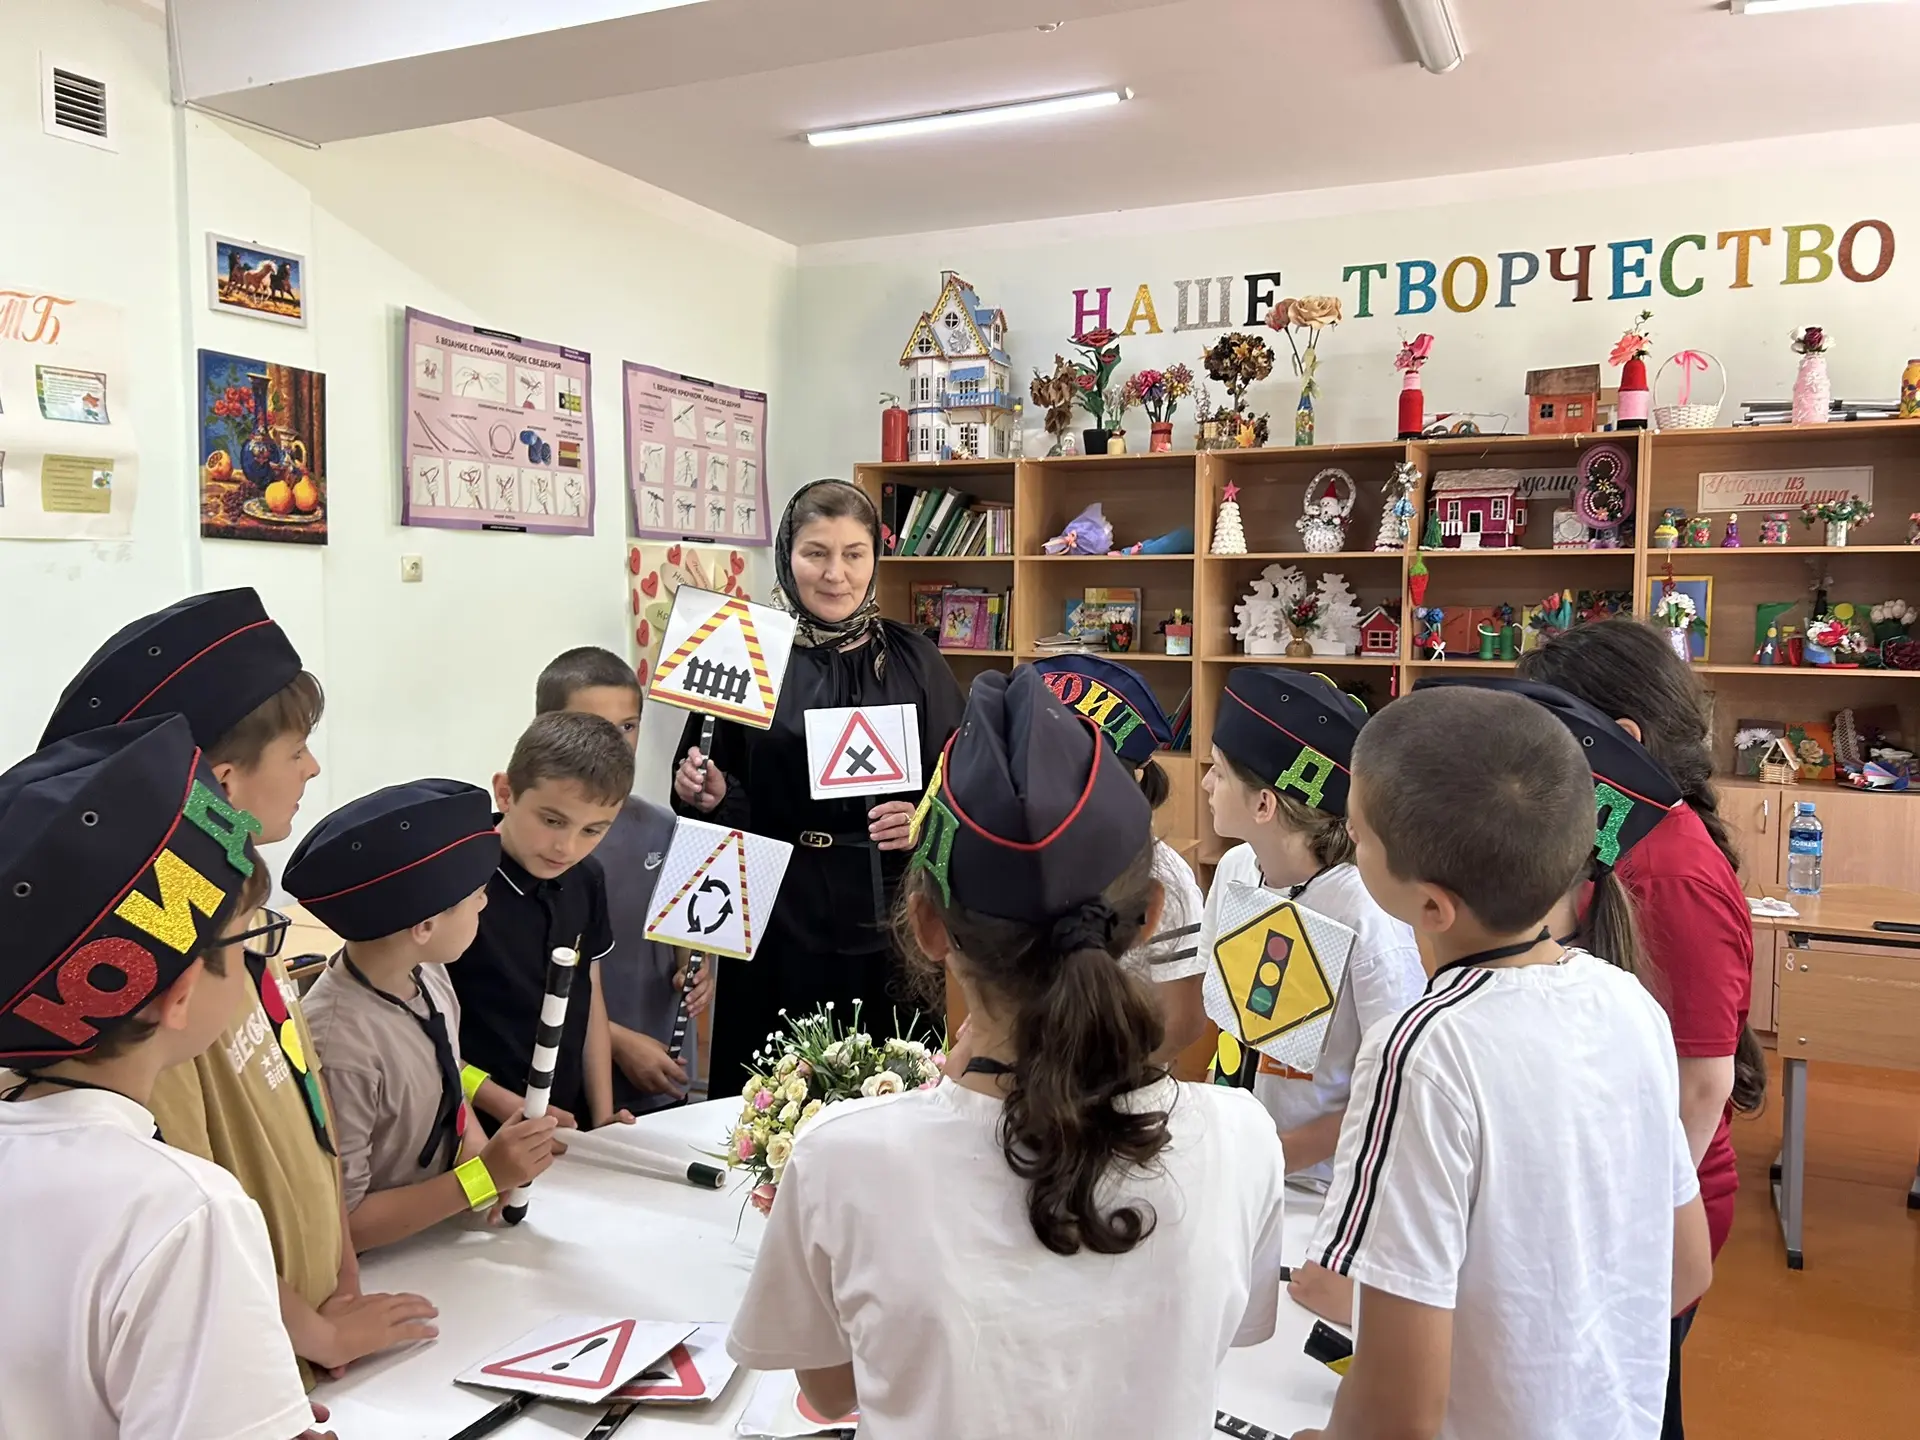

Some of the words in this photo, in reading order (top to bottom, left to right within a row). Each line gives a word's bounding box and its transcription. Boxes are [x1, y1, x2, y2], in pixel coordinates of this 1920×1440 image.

[1072, 272, 1281, 339] НАШЕ
[1342, 219, 1895, 318] ТВОРЧЕСТВО
[441, 336, 469, 352] ВЯЗАНИЕ
[528, 356, 562, 370] СВЕДЕНИЯ
[13, 779, 264, 1047] ЮИД
[1785, 952, 1795, 971] 8
